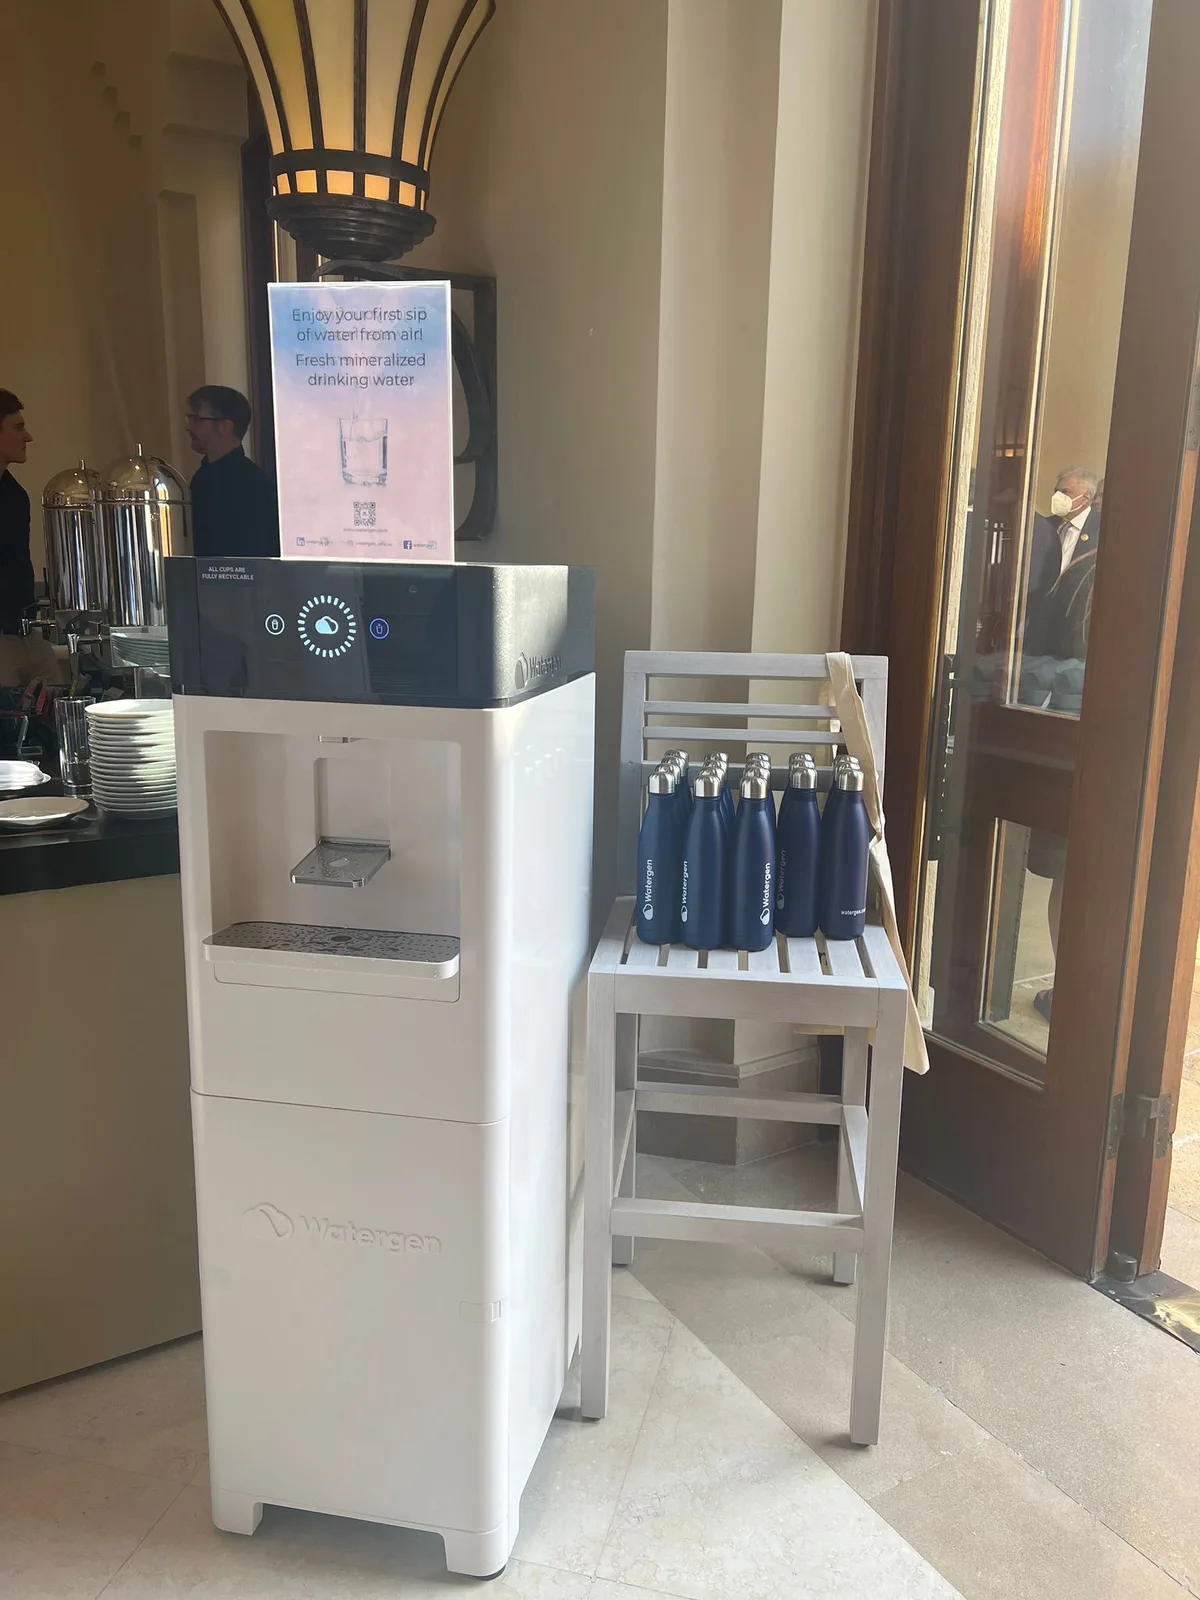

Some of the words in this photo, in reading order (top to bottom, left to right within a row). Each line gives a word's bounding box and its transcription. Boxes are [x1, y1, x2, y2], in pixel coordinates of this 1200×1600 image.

[292, 308, 332, 324] Enjoy
[335, 310, 368, 324] your
[373, 308, 402, 321] first
[405, 308, 428, 324] sip
[297, 328, 311, 341] of
[314, 329, 356, 341] water
[360, 328, 397, 341] from
[400, 327, 424, 341] air!
[296, 353, 336, 367] Fresh
[340, 352, 426, 367] mineralized
[308, 372, 369, 389] drinking
[373, 374, 415, 387] water
[645, 859, 654, 902] Watergen
[762, 862, 771, 908] Watergen
[778, 850, 787, 892] Watergen
[299, 1215, 442, 1254] Watergen
